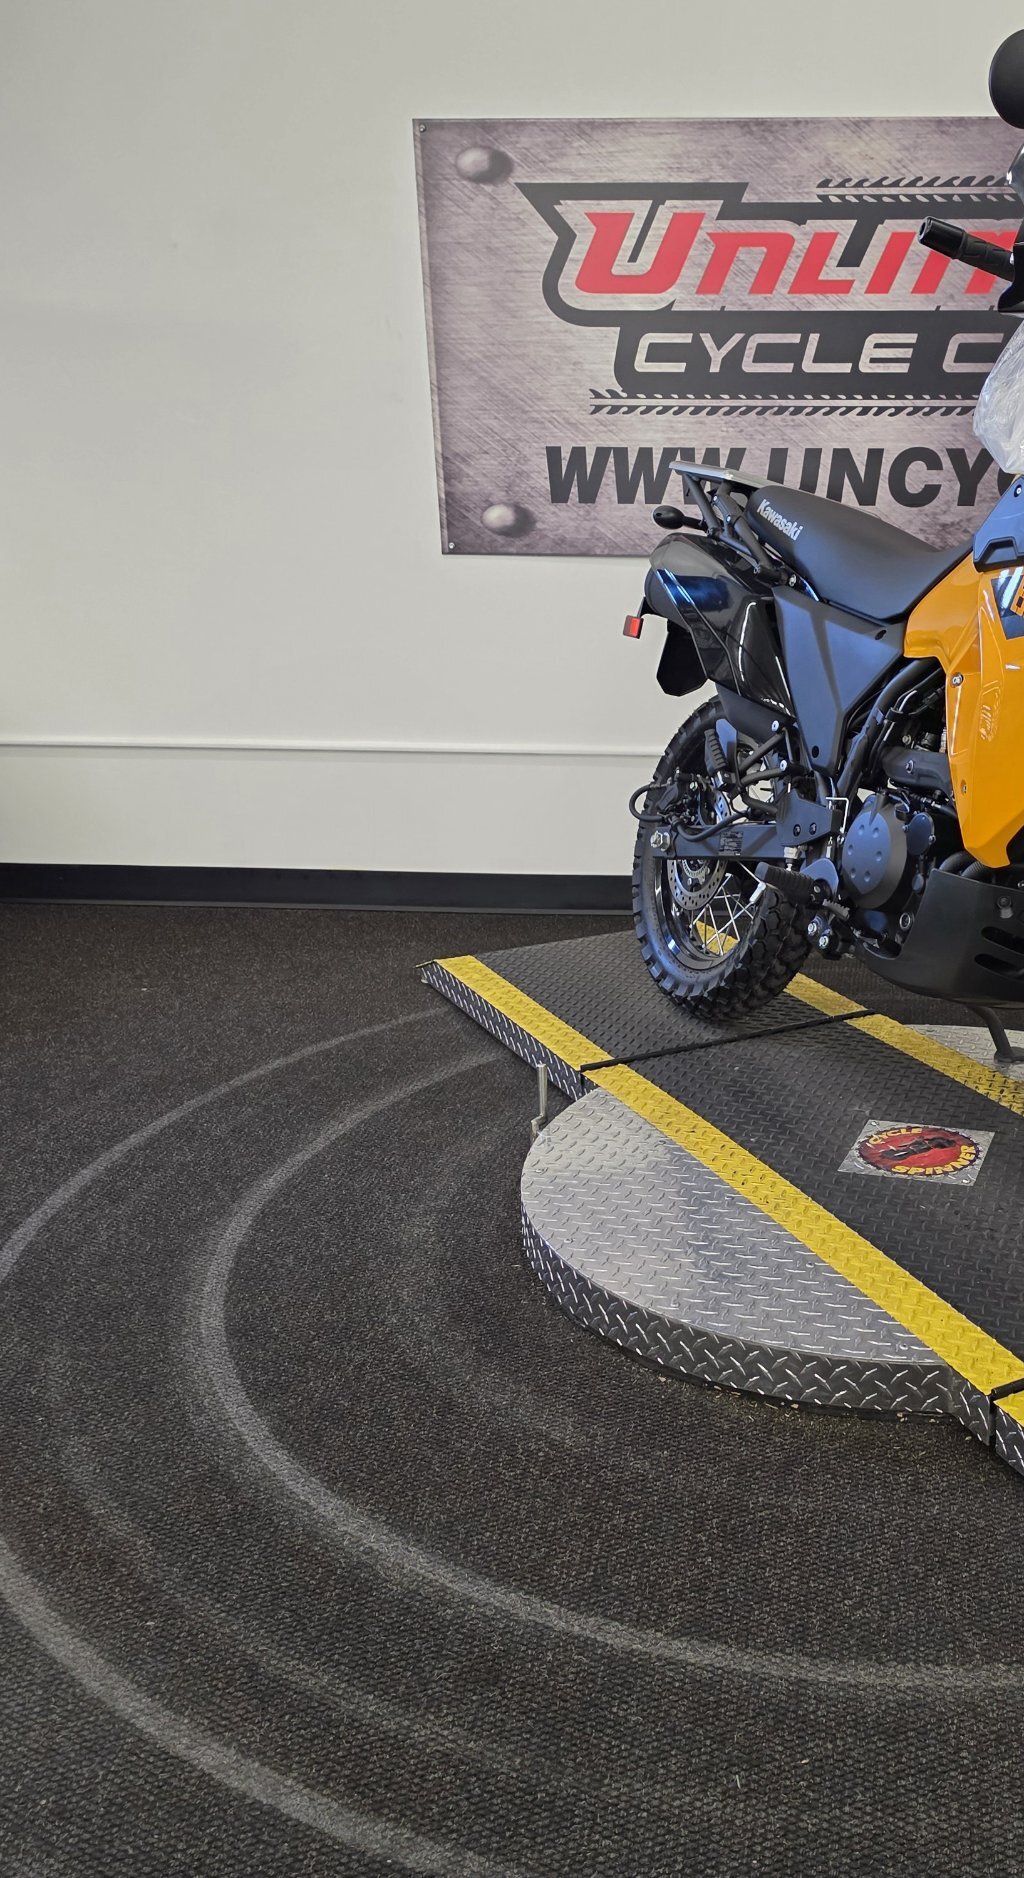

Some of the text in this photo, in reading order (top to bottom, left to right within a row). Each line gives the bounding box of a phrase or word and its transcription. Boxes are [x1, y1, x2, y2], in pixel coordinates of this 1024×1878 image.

[633, 332, 919, 373] CYCLE
[757, 499, 803, 540] Kawasaki
[868, 1127, 923, 1145] CYCLE
[891, 1144, 977, 1175] SPINNER
